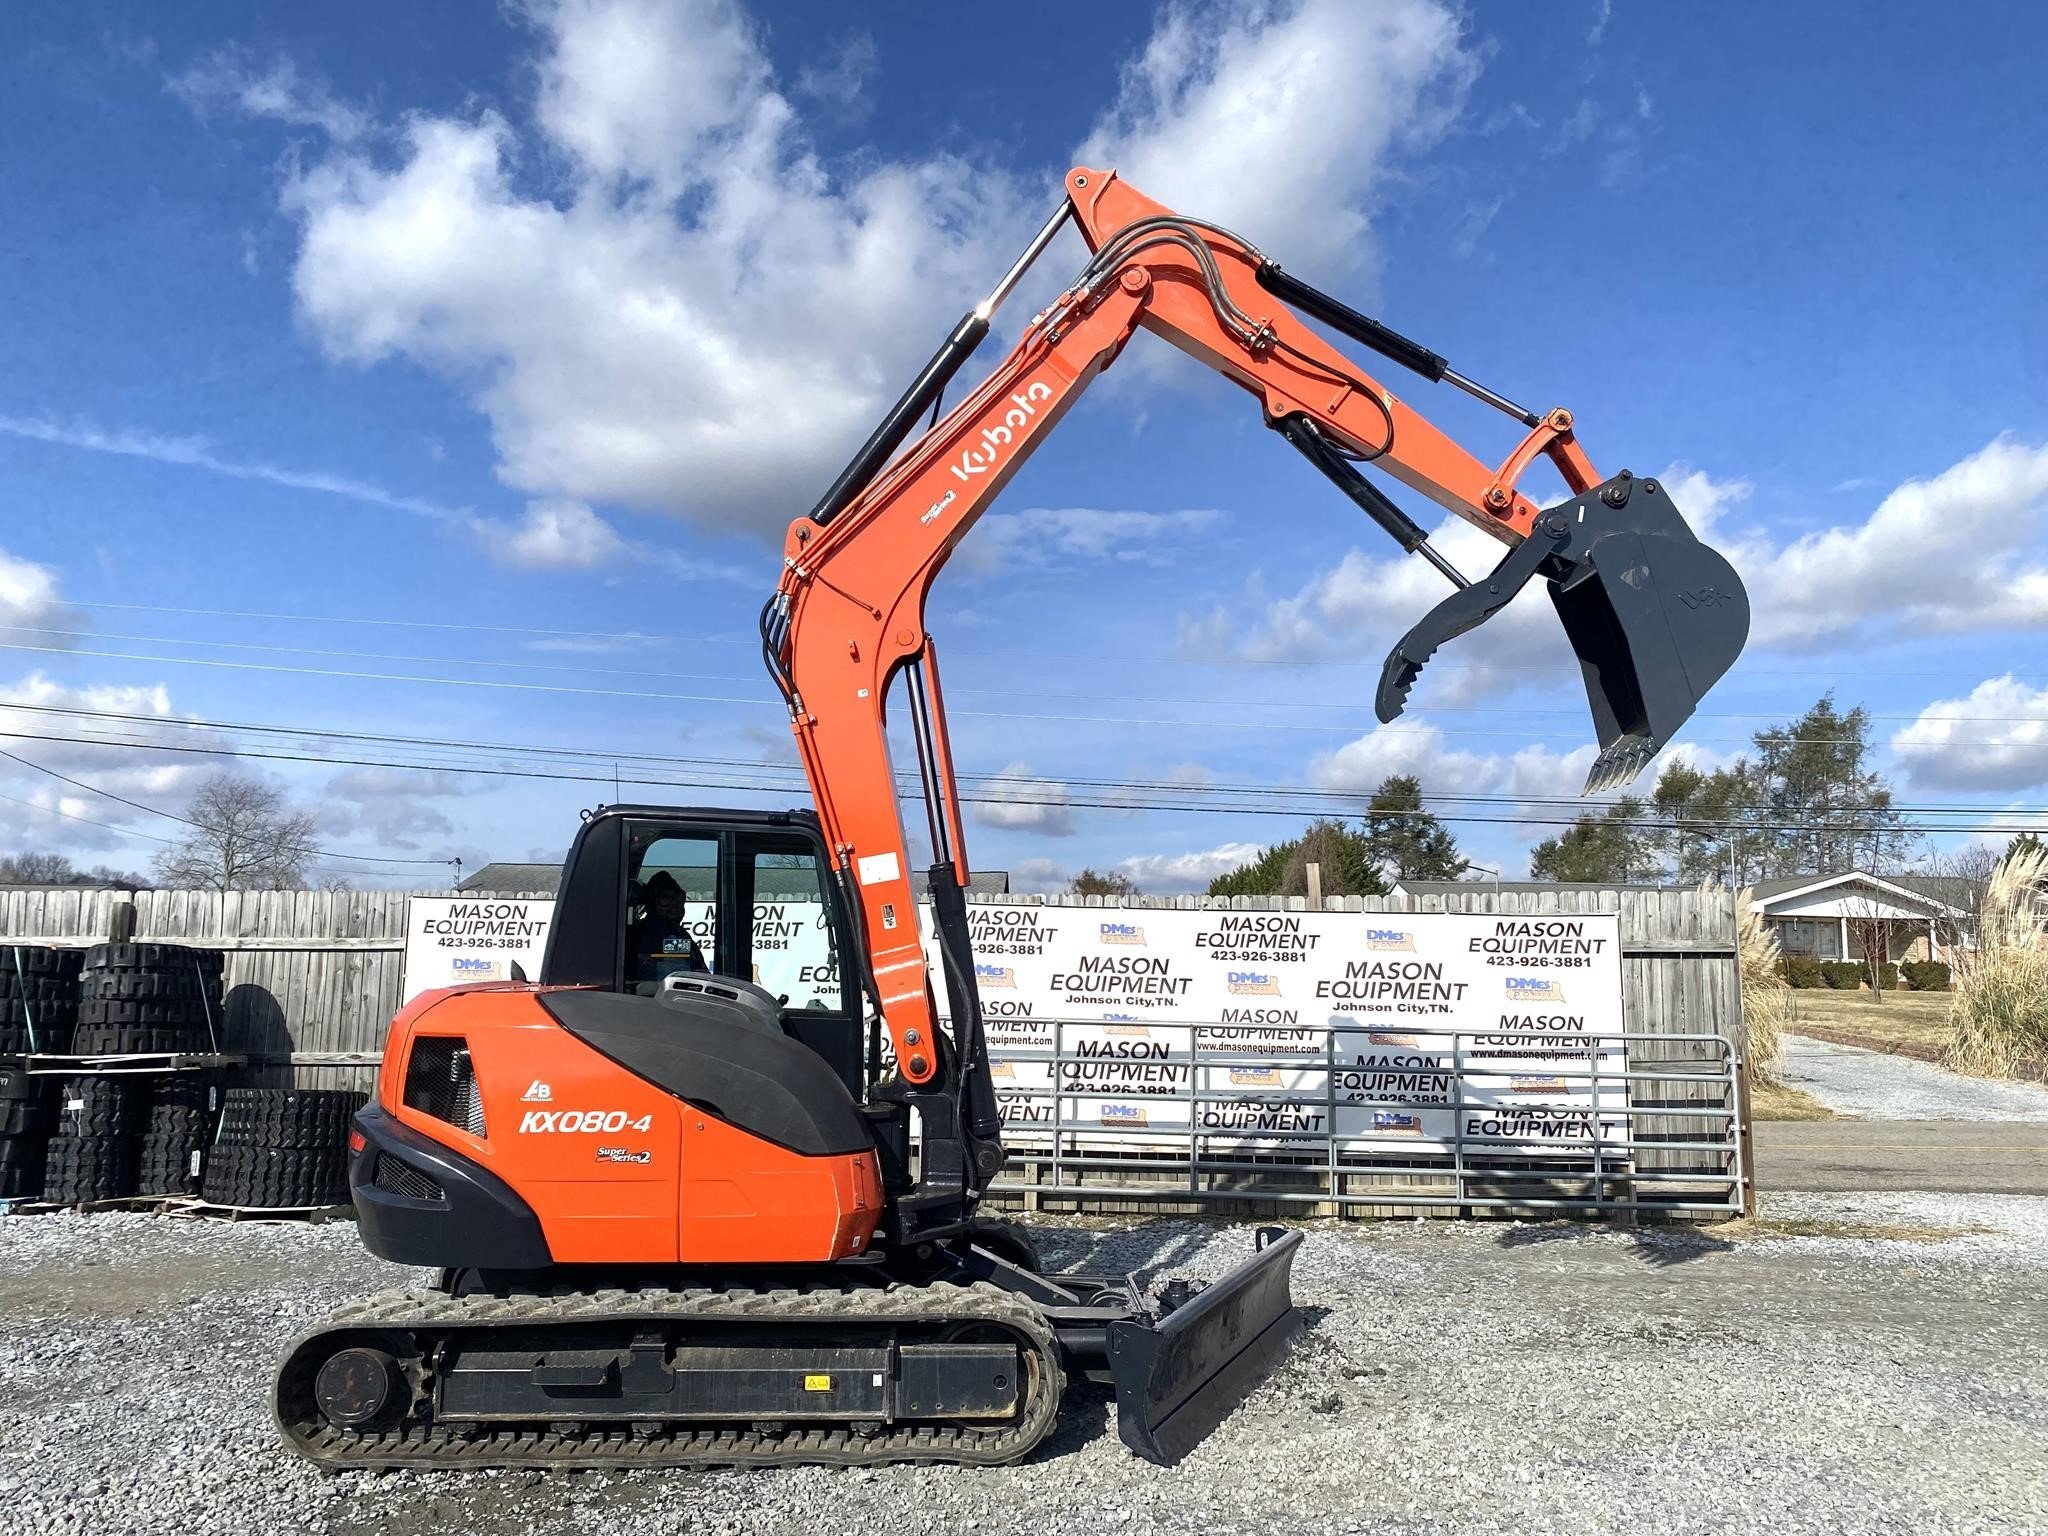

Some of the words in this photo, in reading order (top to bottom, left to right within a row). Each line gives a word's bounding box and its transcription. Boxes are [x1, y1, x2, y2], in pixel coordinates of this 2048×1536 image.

[950, 382, 1053, 482] Kubota
[449, 904, 528, 919] MASON
[423, 920, 547, 936] EQUIPMENT
[1220, 917, 1300, 932] MASON
[1495, 922, 1584, 938] MASON
[438, 938, 531, 949] 423-926-3881
[1195, 933, 1320, 949] EQUIPMENT
[1469, 938, 1606, 954] EQUIPMENT
[1211, 951, 1306, 962] 423-926-3881
[1486, 956, 1591, 967] 423-926-3881
[1079, 956, 1170, 975] MASON
[1346, 962, 1442, 980] MASON
[1050, 974, 1193, 994] EQUIPMENT
[1316, 981, 1468, 1000] EQUIPMENT
[1066, 995, 1120, 1004] Johnson
[1333, 1003, 1392, 1012] Johnson
[980, 1001, 1032, 1016] ASON
[1221, 1008, 1298, 1024] MASON
[1500, 1015, 1584, 1031] MASON
[1076, 1040, 1170, 1060] MASON
[519, 1111, 652, 1133] KX080-4
[597, 1147, 627, 1156] Super
